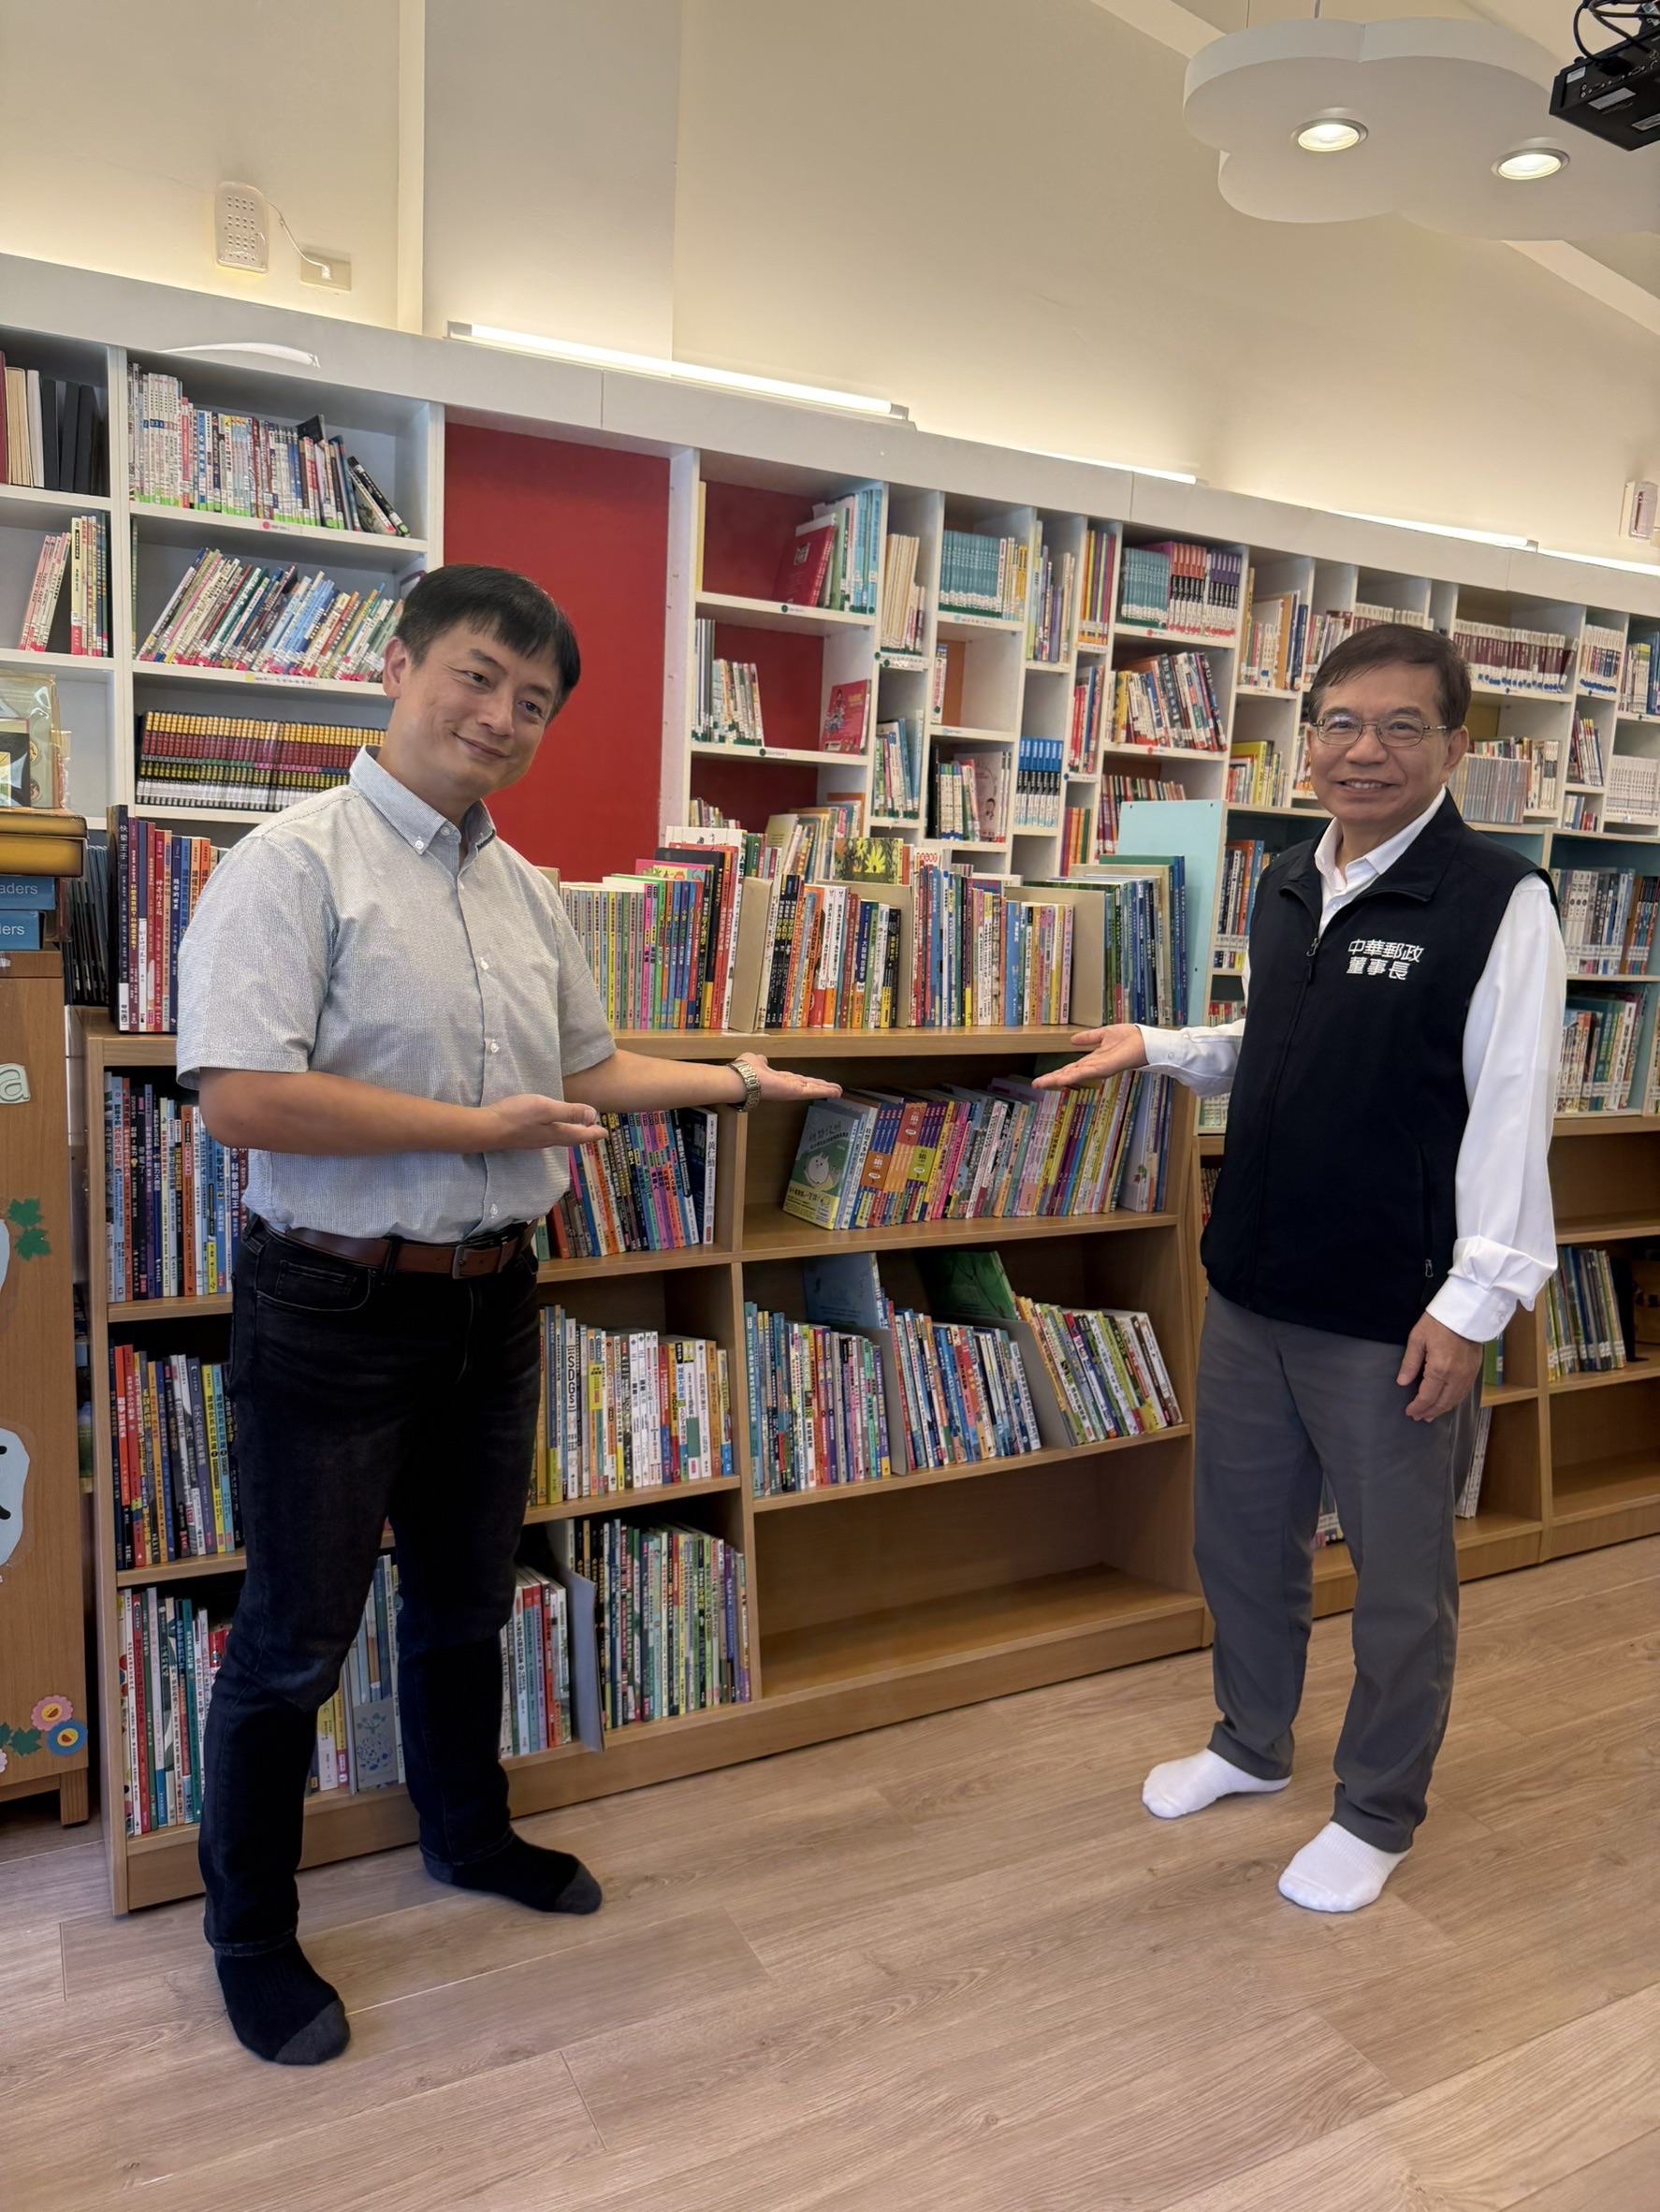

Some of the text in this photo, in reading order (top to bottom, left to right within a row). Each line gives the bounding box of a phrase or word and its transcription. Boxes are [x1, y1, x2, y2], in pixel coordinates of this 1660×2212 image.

[0, 882, 37, 895] aders
[1347, 939, 1425, 964] 中華郵政
[1347, 956, 1410, 981] 董事長
[706, 1141, 716, 1168] 黃仁勳
